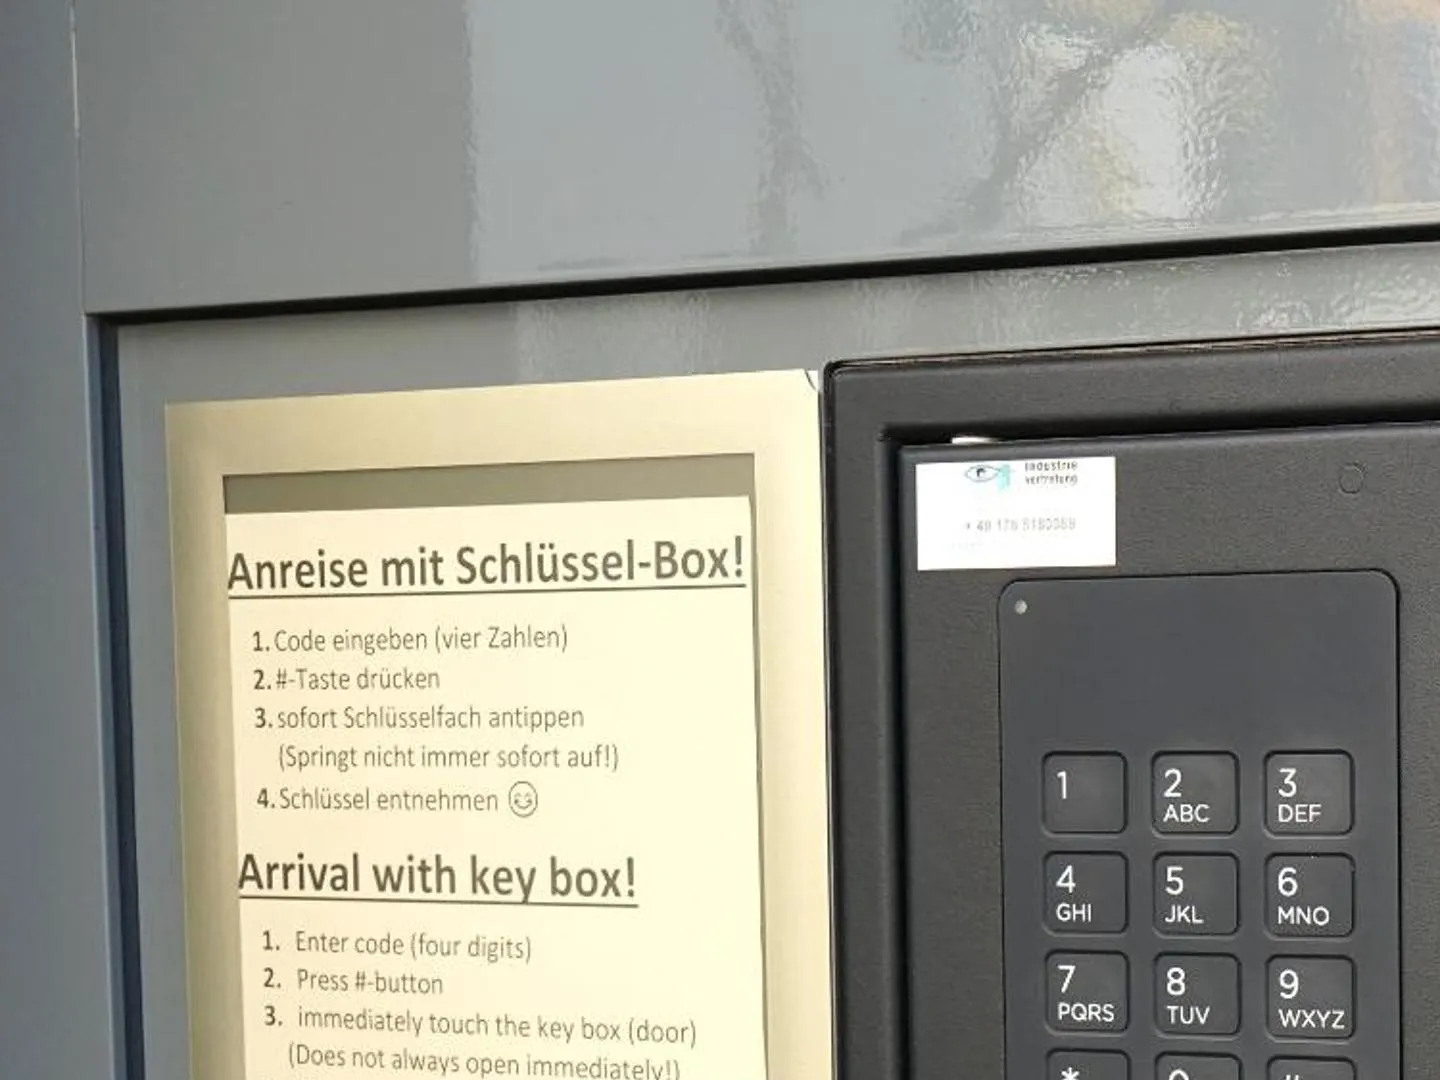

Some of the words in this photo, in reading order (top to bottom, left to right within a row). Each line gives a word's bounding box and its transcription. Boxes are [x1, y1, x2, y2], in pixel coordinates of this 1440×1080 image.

[227, 549, 368, 590] Anreise
[381, 546, 444, 586] mit
[457, 535, 744, 585] Schlüssel-Box!
[253, 630, 271, 652] 1.
[274, 629, 326, 652] Code
[333, 627, 427, 654] eingeben
[435, 626, 481, 653] (vier
[488, 624, 568, 651] Zahlen)
[253, 670, 272, 691] 2.
[275, 668, 350, 690] #-Taste
[356, 667, 440, 690] drücken
[254, 708, 273, 729] 3.
[277, 707, 337, 729] sofort
[344, 706, 481, 728] Schlüsselfach
[488, 706, 584, 733] antippen
[278, 744, 357, 772] (Springt
[364, 745, 415, 768] nicht
[421, 746, 489, 768] immer
[497, 745, 560, 769] sofort
[566, 744, 619, 771] auf!)
[1057, 771, 1068, 799] 1
[1163, 769, 1182, 798] 2
[1278, 768, 1297, 798] 3
[257, 790, 275, 810] 4.
[279, 788, 369, 811] Schlüssel
[377, 790, 499, 812] entnehmen
[1163, 803, 1210, 823] ABC
[1277, 804, 1322, 823] DEF
[238, 852, 359, 892] Arrival
[372, 854, 456, 894] with
[471, 855, 536, 901] key
[550, 857, 636, 898] box!
[1056, 865, 1076, 893] 4
[1165, 866, 1184, 895] 5
[1278, 867, 1298, 897] 6
[1056, 903, 1092, 923] GHI
[1165, 905, 1204, 924] JKL
[1278, 906, 1330, 926] MNO
[262, 930, 280, 952] 1.
[295, 931, 348, 954] Enter
[355, 931, 404, 956] code
[411, 933, 461, 958] (four
[468, 933, 531, 964] digits)
[263, 969, 281, 989] 2.
[297, 969, 348, 992] Press
[355, 971, 443, 995] #-button
[1057, 965, 1076, 993] 7
[1166, 967, 1186, 996] 8
[1279, 969, 1299, 999] 9
[1058, 1002, 1115, 1022] PQRS
[1167, 1006, 1210, 1025] TUV
[1279, 1009, 1345, 1029] WXYZ
[264, 1006, 283, 1027] 3.
[298, 1007, 423, 1037] immediately
[429, 1013, 488, 1036] touch
[496, 1015, 531, 1037] the
[537, 1016, 574, 1043] key
[582, 1017, 620, 1042] box
[627, 1018, 697, 1048] (door)
[288, 1043, 346, 1070] (Does
[352, 1048, 385, 1069] not
[392, 1048, 459, 1075] always
[466, 1053, 519, 1078] open
